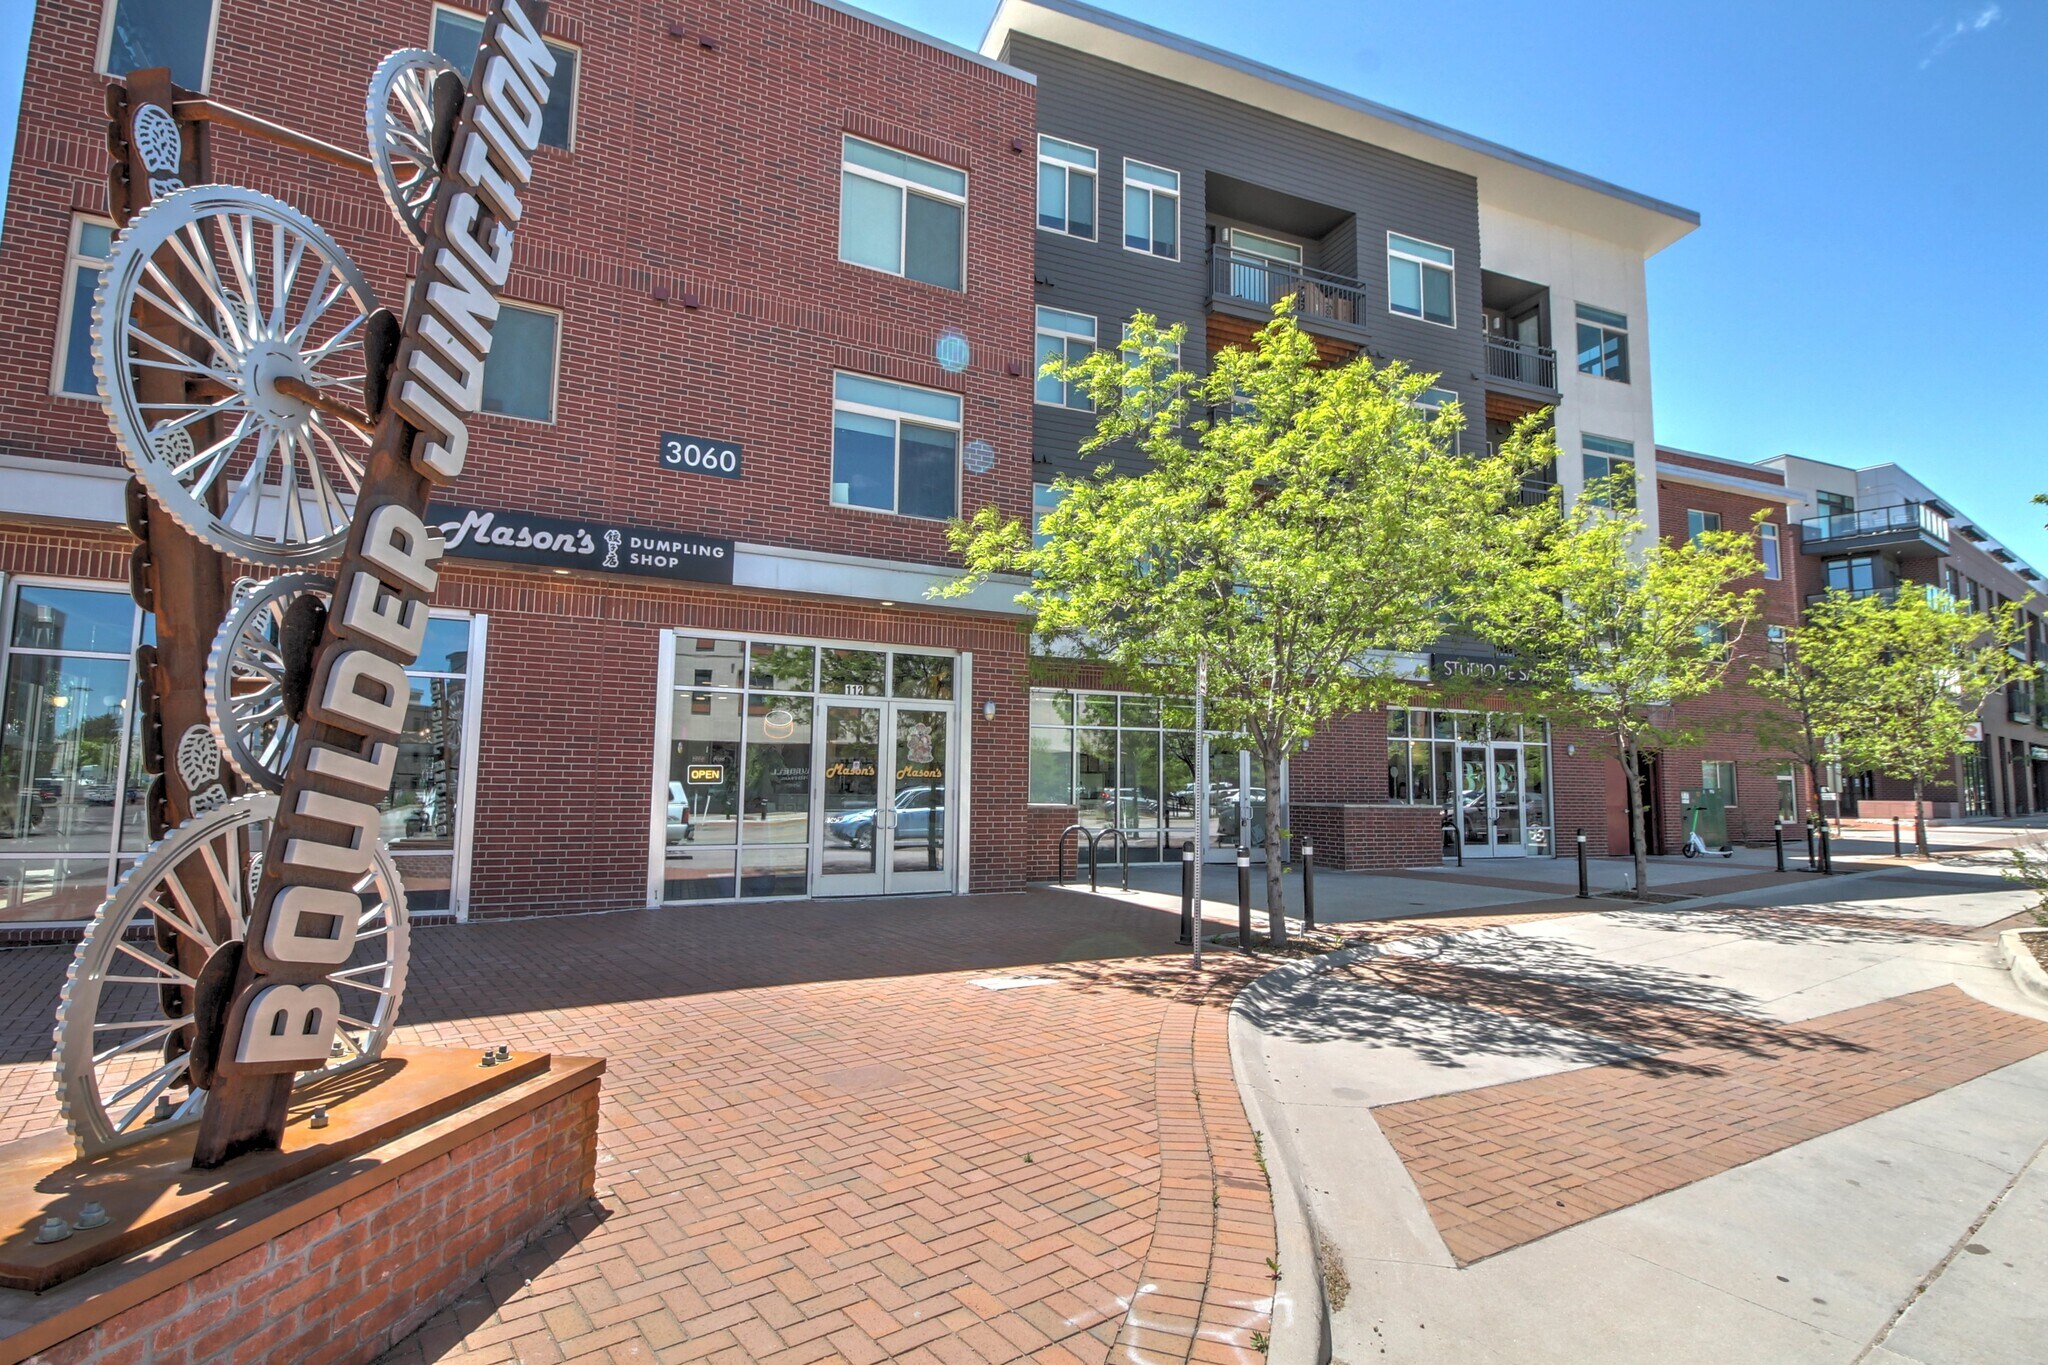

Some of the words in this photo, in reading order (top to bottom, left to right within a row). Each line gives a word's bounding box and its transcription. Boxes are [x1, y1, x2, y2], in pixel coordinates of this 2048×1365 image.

[665, 441, 736, 472] 3060
[235, 504, 446, 1064] BOULDER
[401, 0, 557, 478] JUNCTION
[438, 510, 595, 554] Mason's
[630, 537, 725, 558] DUMPLING
[630, 553, 679, 568] SHOP
[1443, 660, 1496, 678] STUDIO
[846, 685, 863, 695] 112
[691, 770, 720, 779] OPEN
[826, 763, 875, 778] Mason's
[896, 765, 942, 780] Mason's
